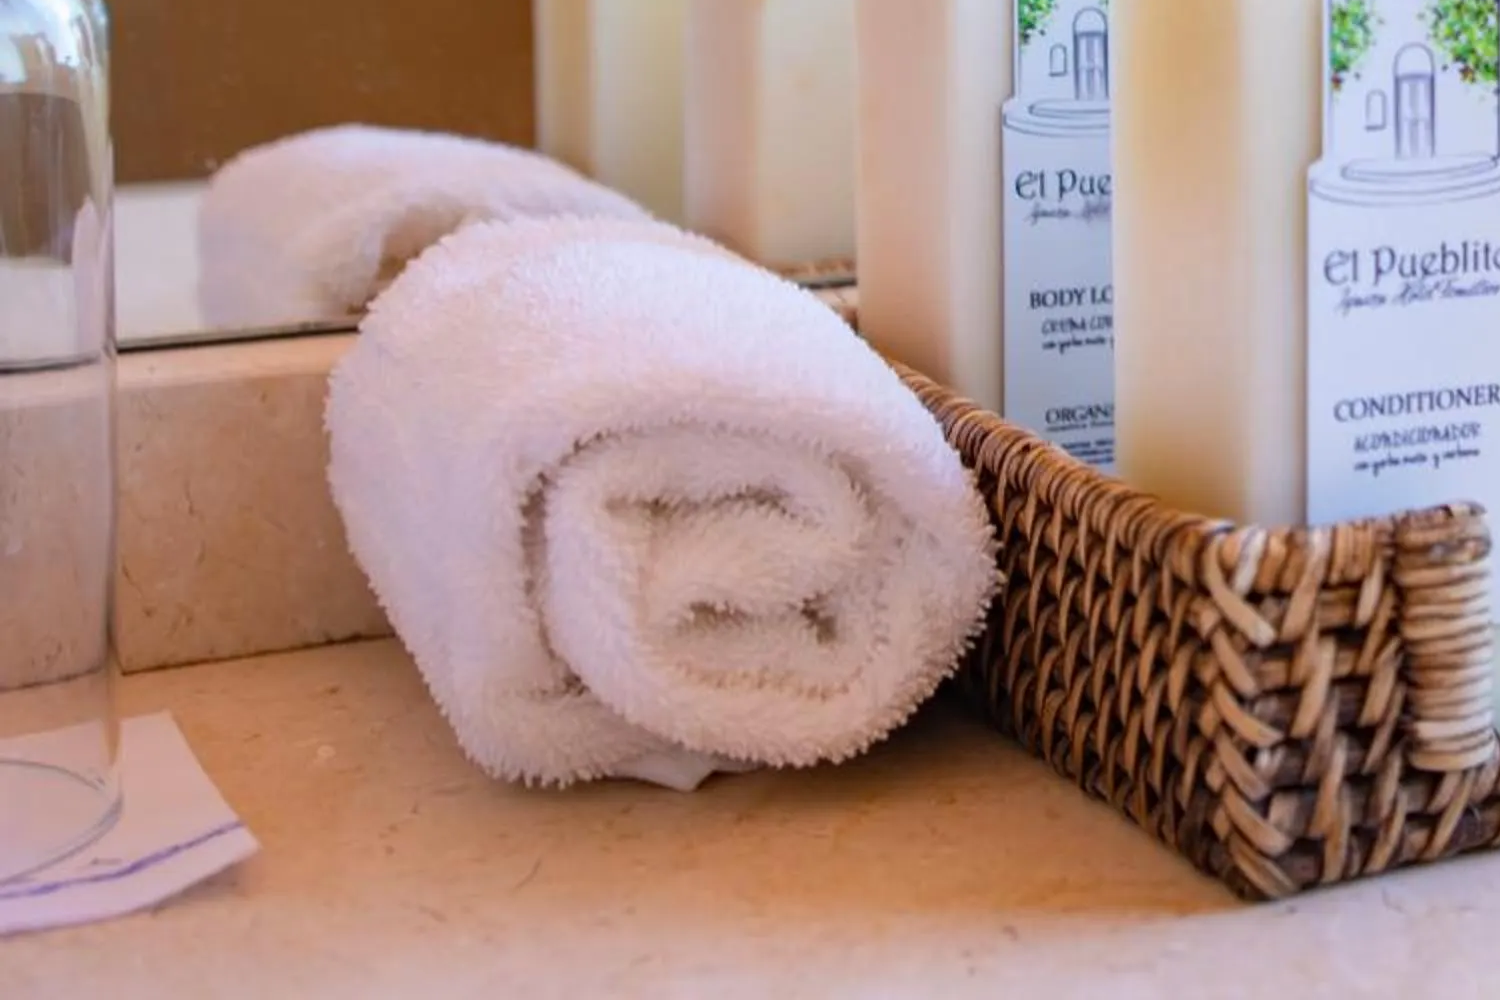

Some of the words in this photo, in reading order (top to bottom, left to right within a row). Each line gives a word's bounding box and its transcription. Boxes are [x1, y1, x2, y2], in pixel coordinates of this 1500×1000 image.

[1015, 169, 1045, 200] El
[1323, 249, 1359, 286] El
[1030, 287, 1086, 310] BODY
